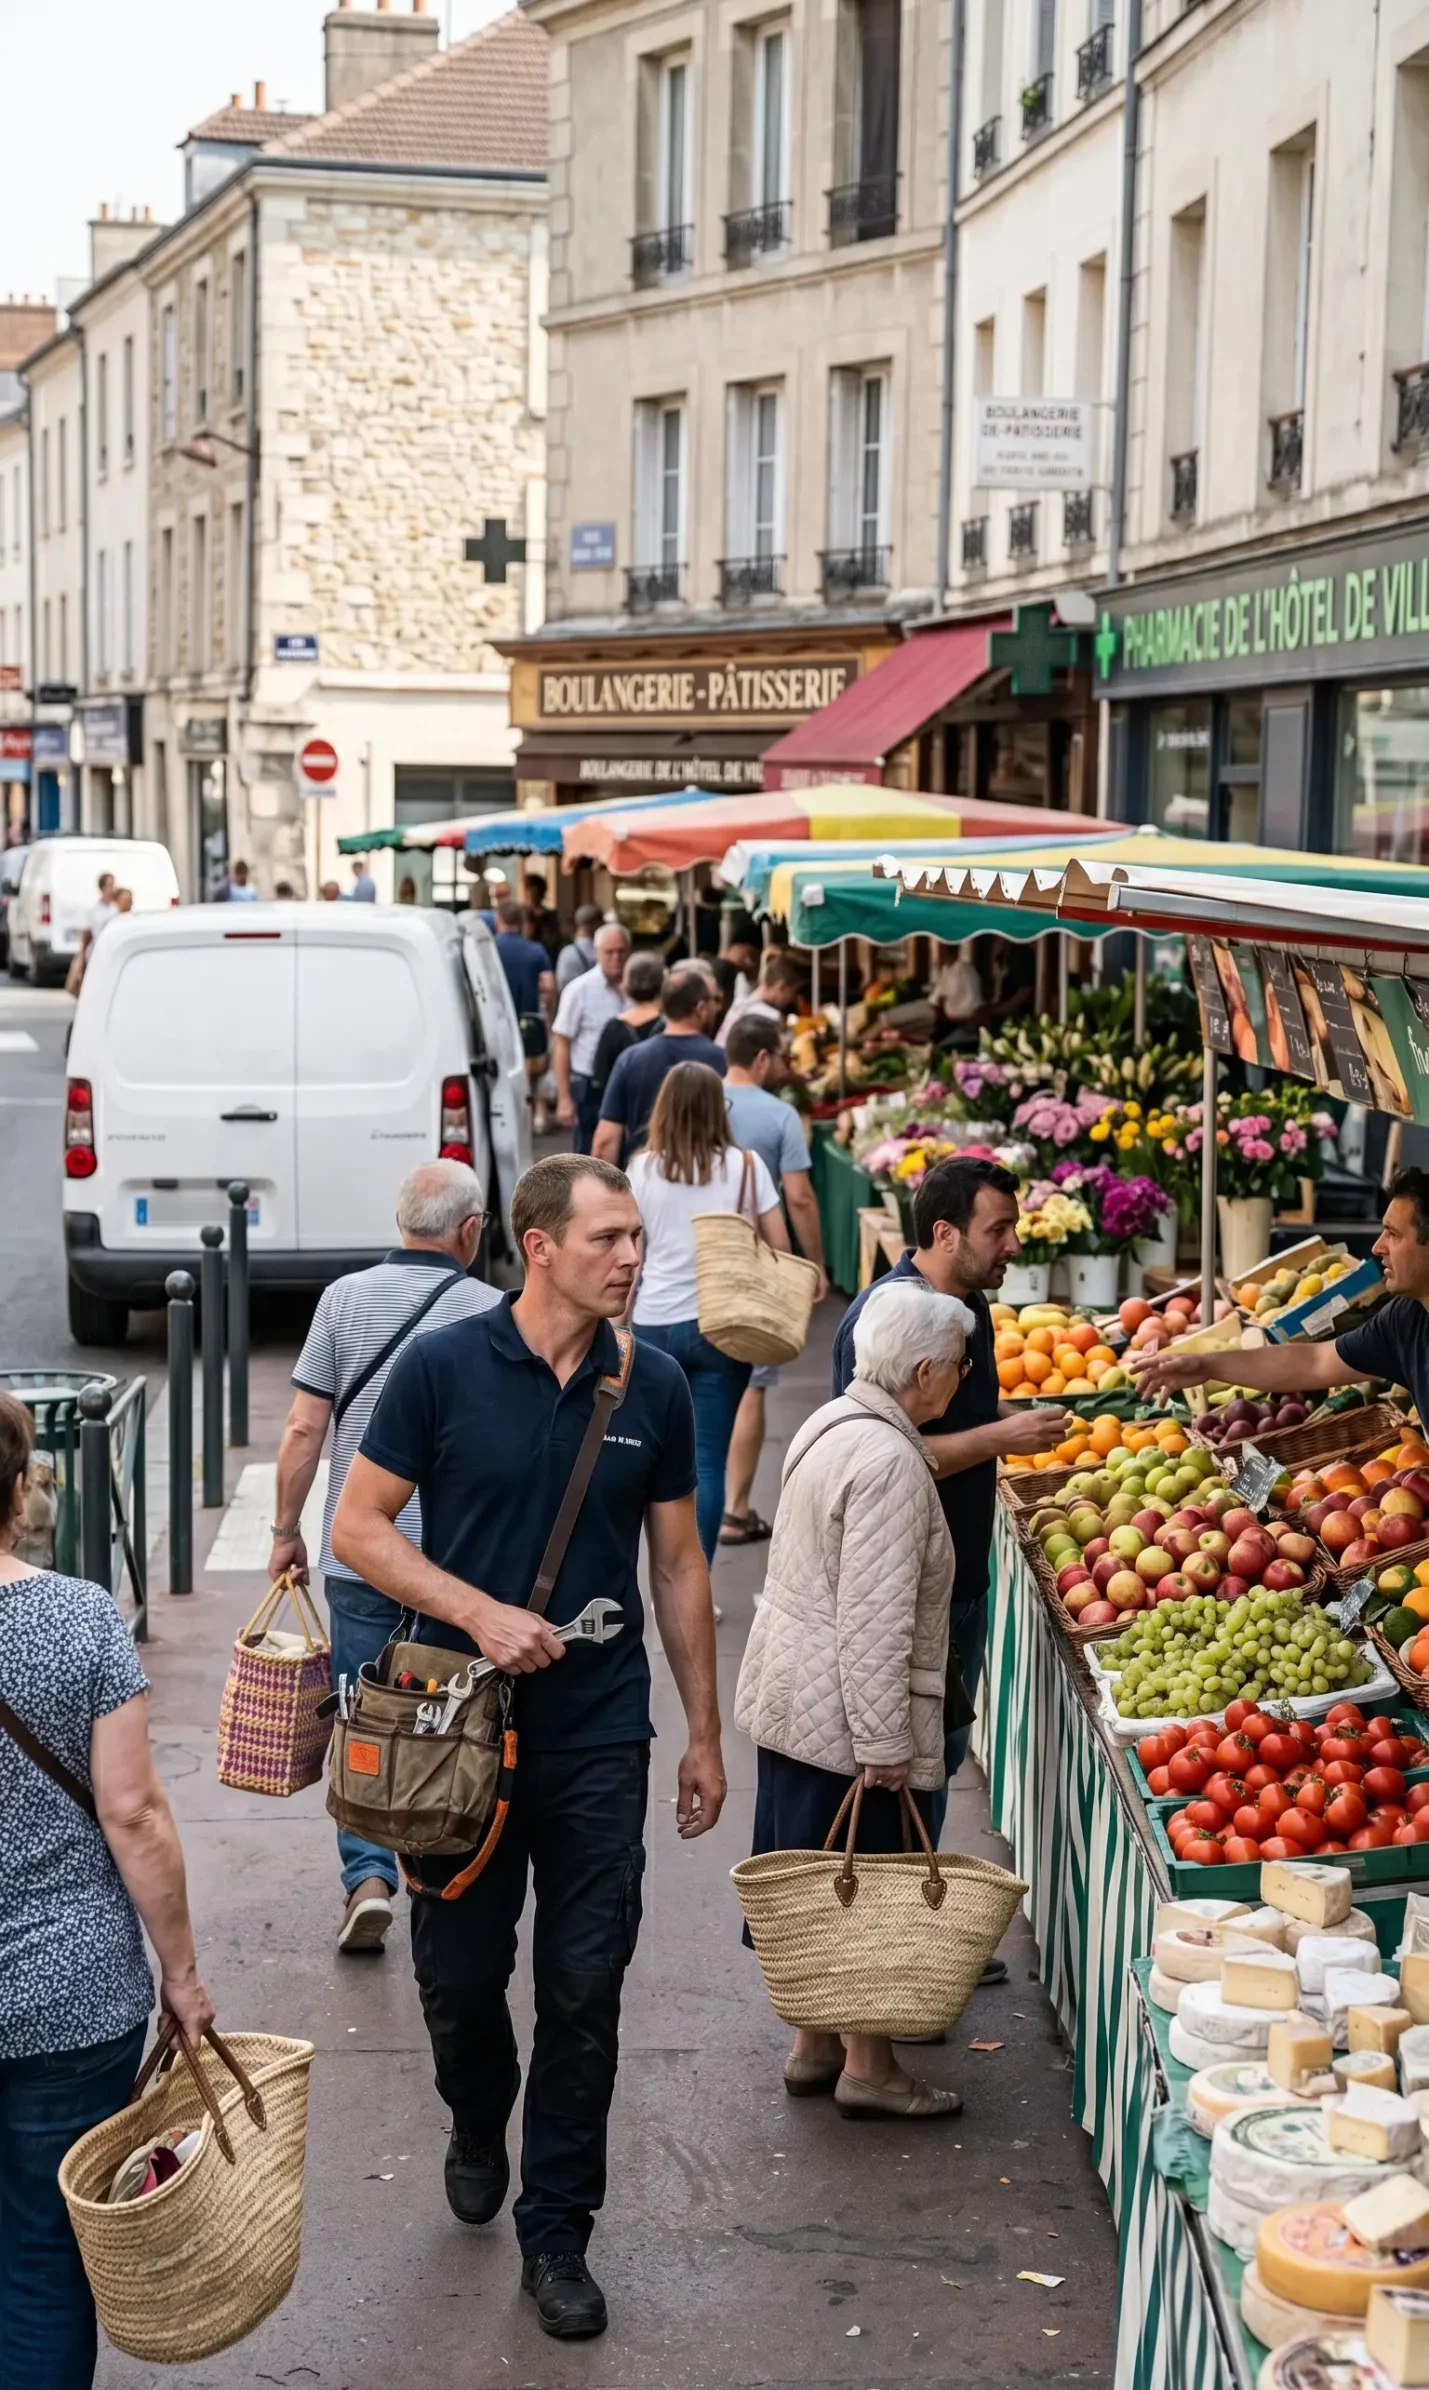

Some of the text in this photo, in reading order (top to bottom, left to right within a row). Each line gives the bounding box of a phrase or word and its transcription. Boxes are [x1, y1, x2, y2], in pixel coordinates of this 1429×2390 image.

[1123, 600, 1220, 670] PHARMACIE
[1224, 594, 1250, 657] DE
[1254, 566, 1338, 653] L'HÔTEL
[1344, 569, 1375, 641] DE
